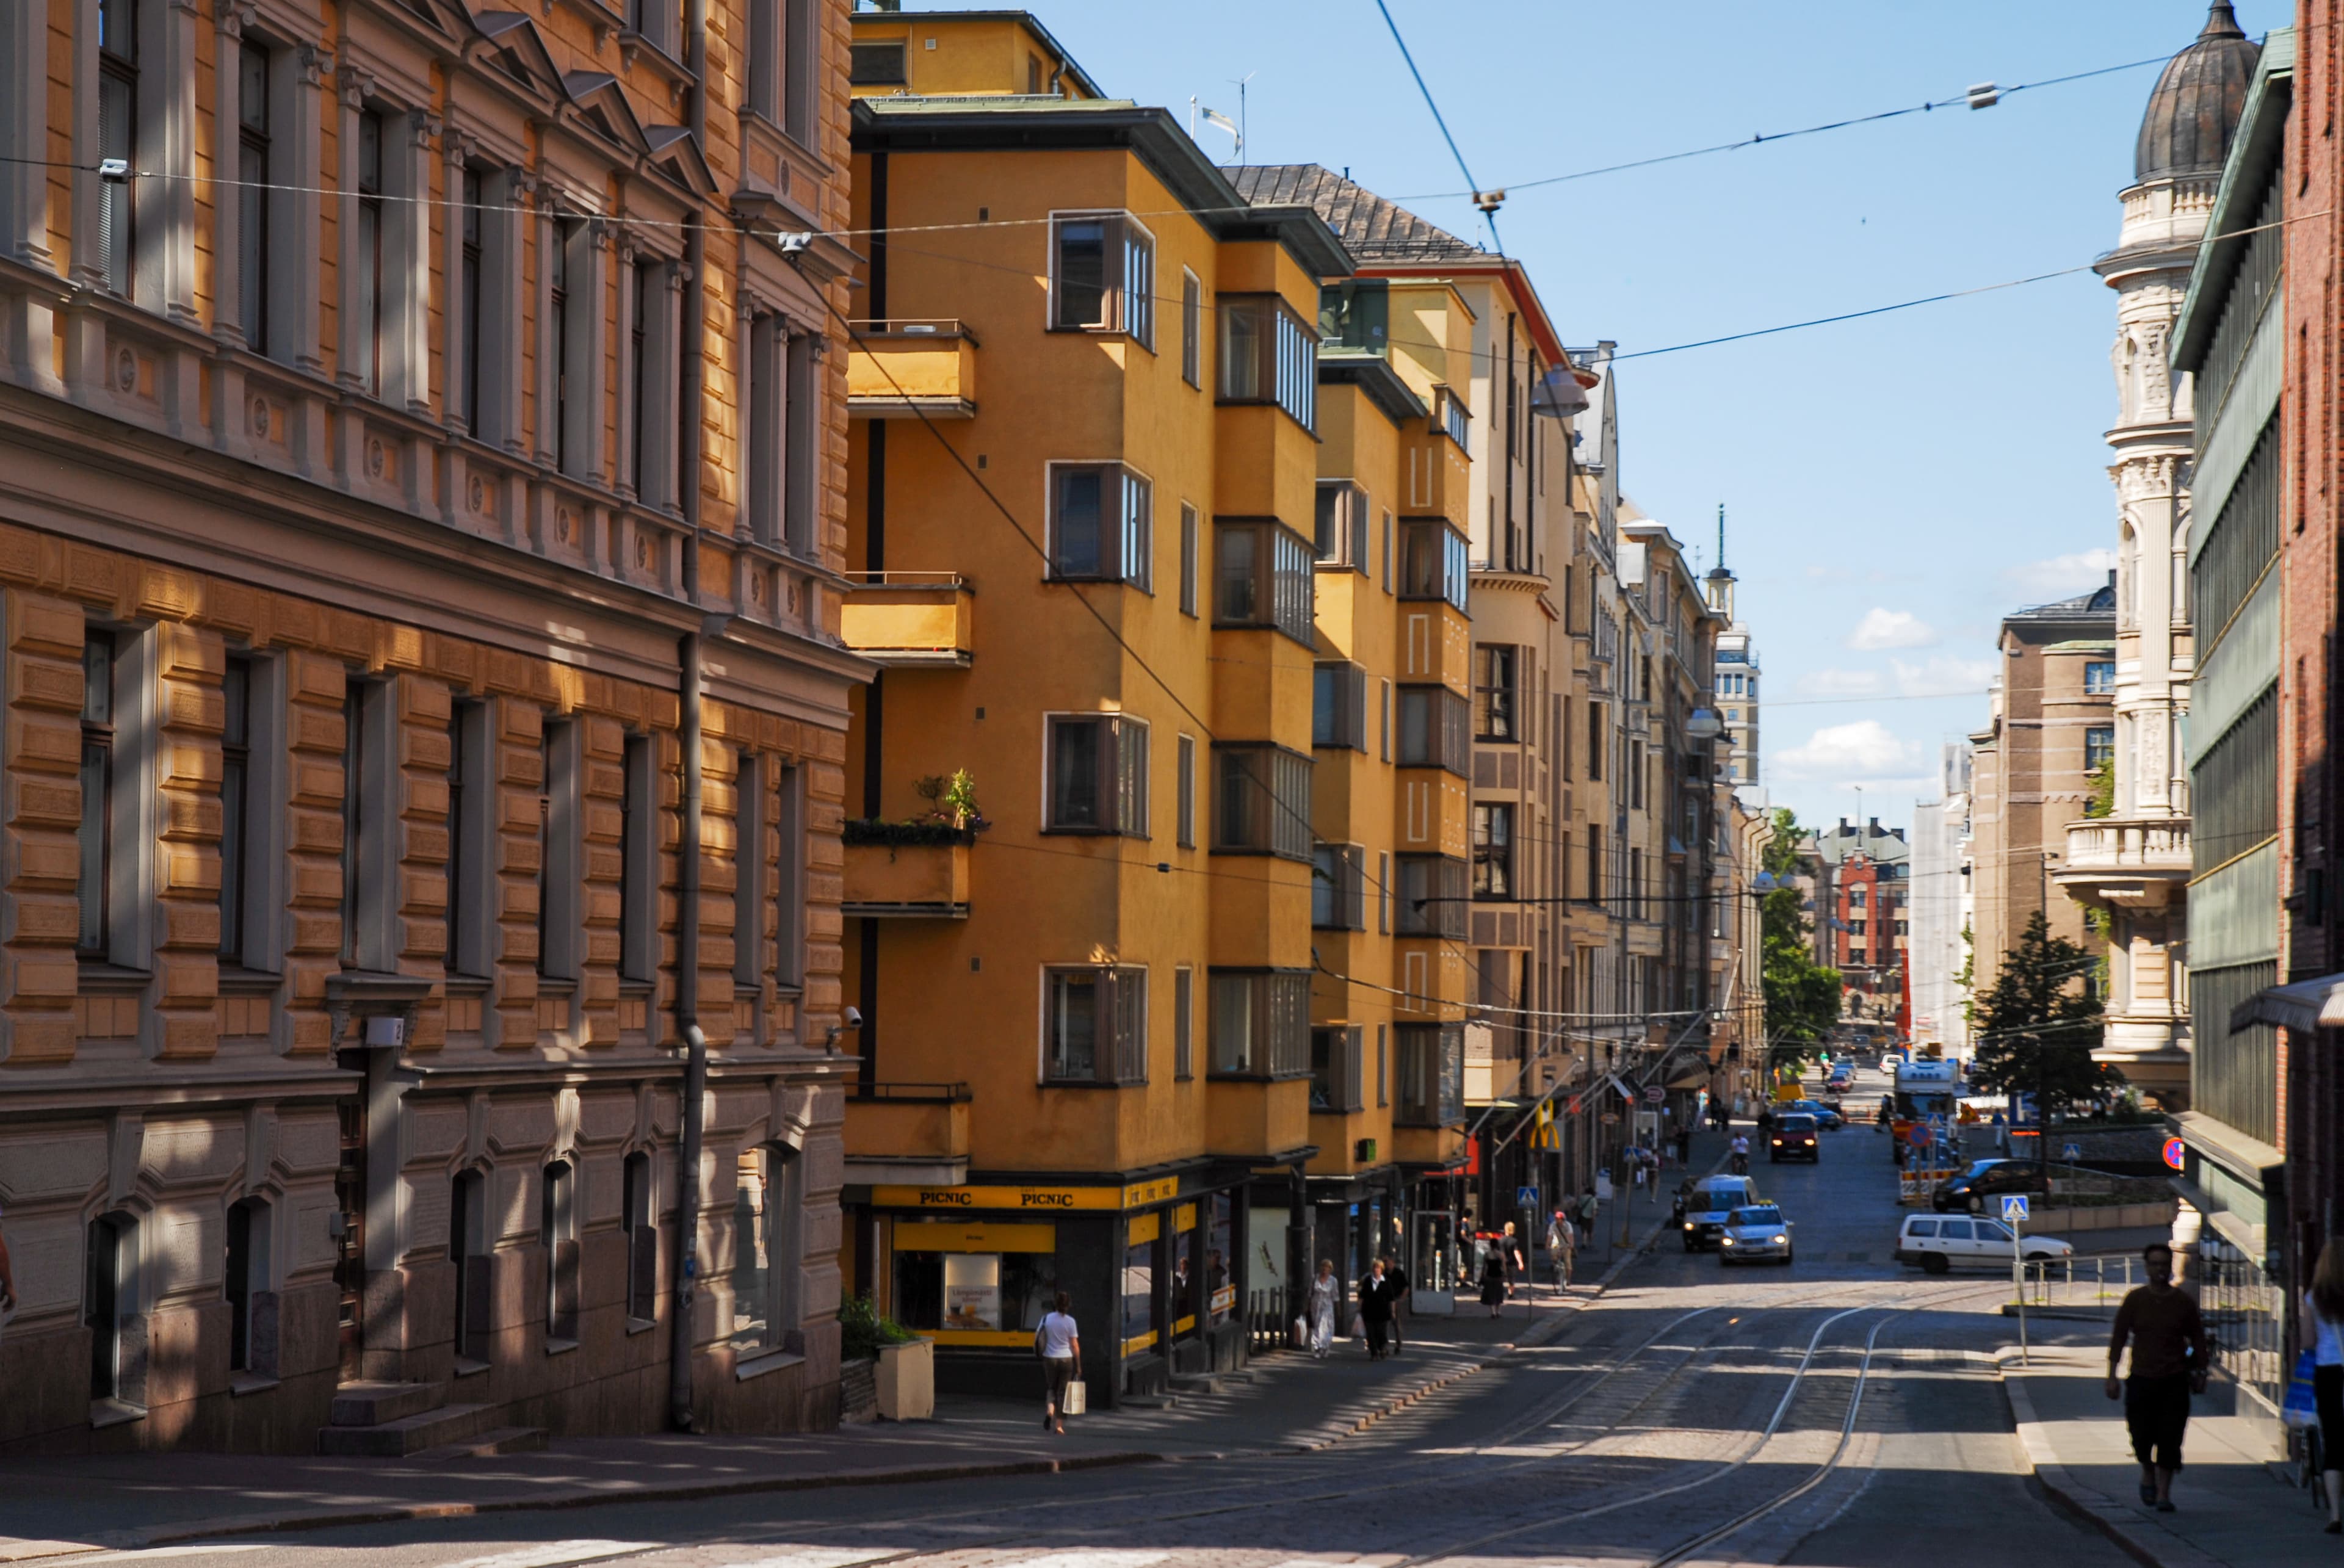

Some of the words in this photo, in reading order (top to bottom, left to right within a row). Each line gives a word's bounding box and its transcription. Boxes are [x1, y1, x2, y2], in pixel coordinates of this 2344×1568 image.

[396, 1024, 402, 1039] 2
[920, 1192, 972, 1205] PICNIC
[1021, 1193, 1074, 1207] PICNIC
